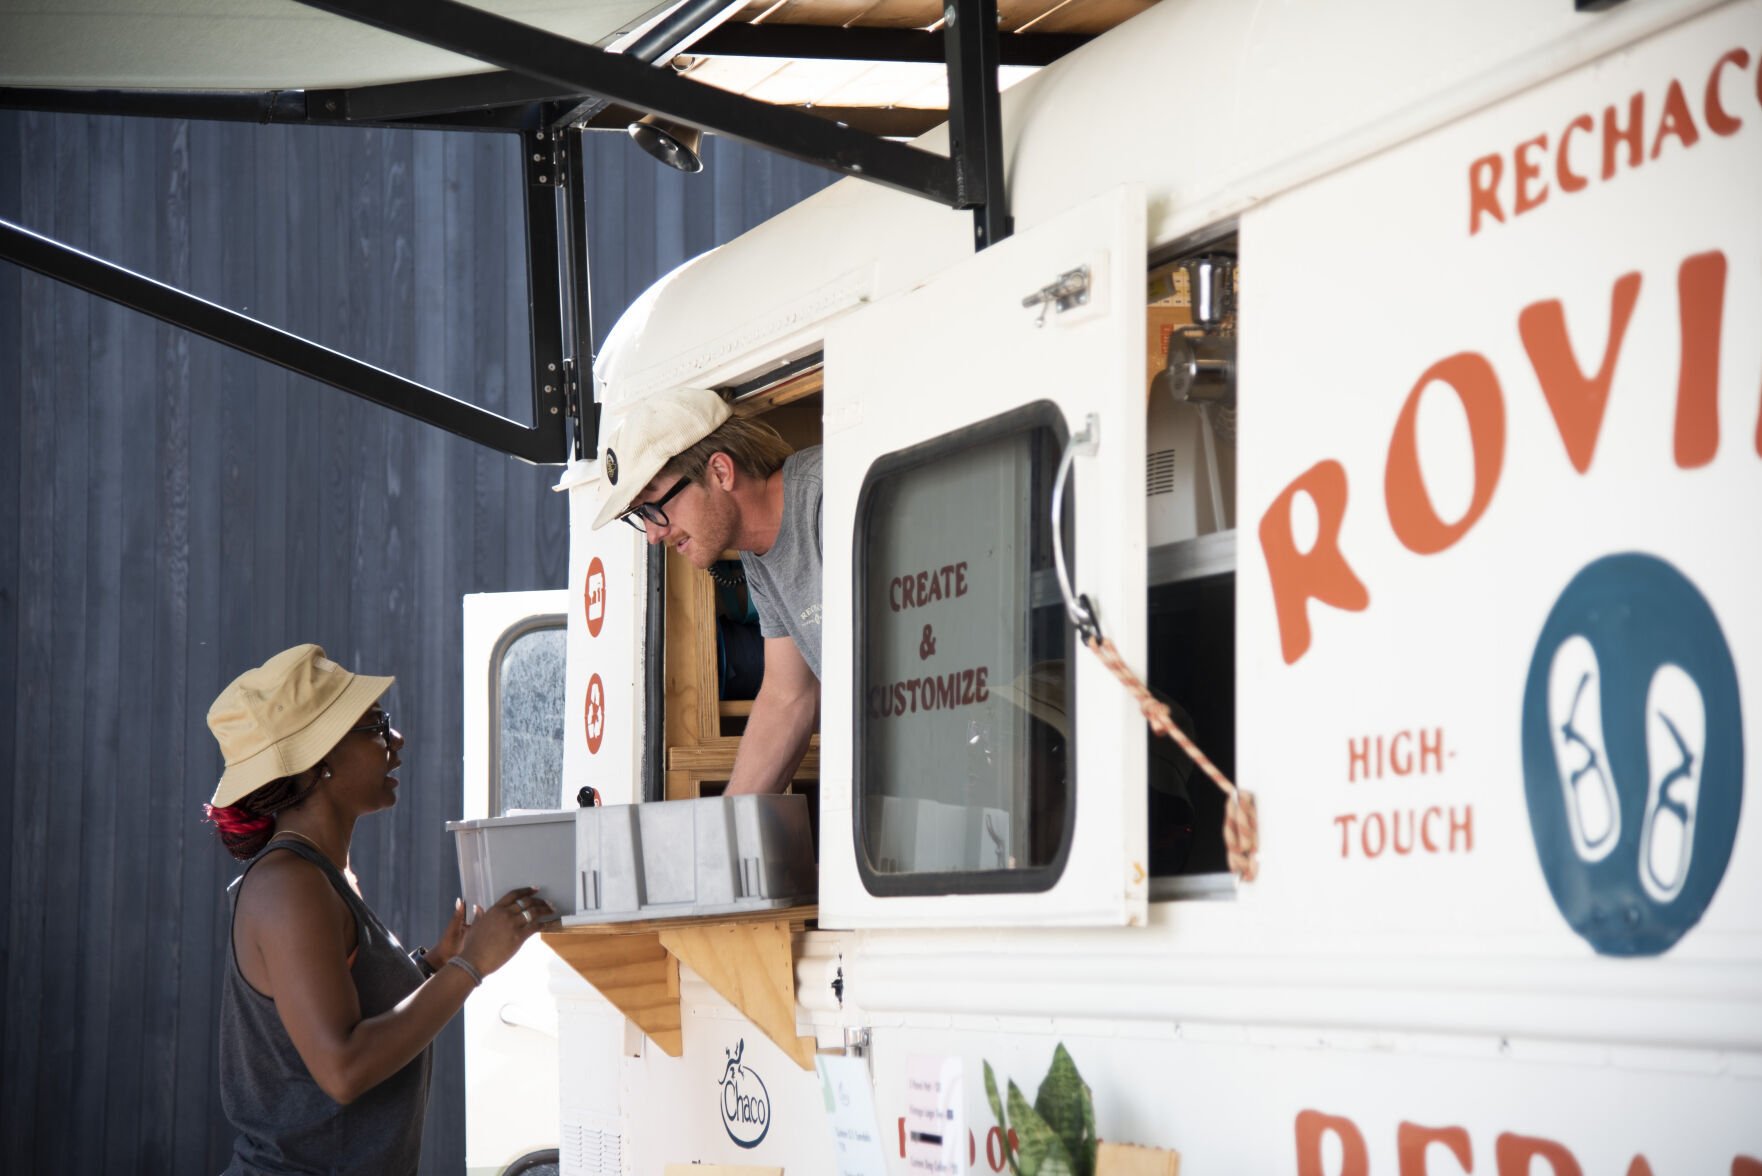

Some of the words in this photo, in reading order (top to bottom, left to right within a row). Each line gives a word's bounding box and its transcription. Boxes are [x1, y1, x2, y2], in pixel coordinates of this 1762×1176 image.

[1469, 48, 1762, 235] RECHAC
[1258, 250, 1762, 666] ROVI
[889, 561, 968, 612] CREATE
[919, 623, 936, 660] &
[870, 666, 989, 719] CUSTOMIZE
[1349, 727, 1456, 782] HIGH-
[1334, 805, 1473, 859] TOUCH
[724, 1080, 765, 1124] Chaco
